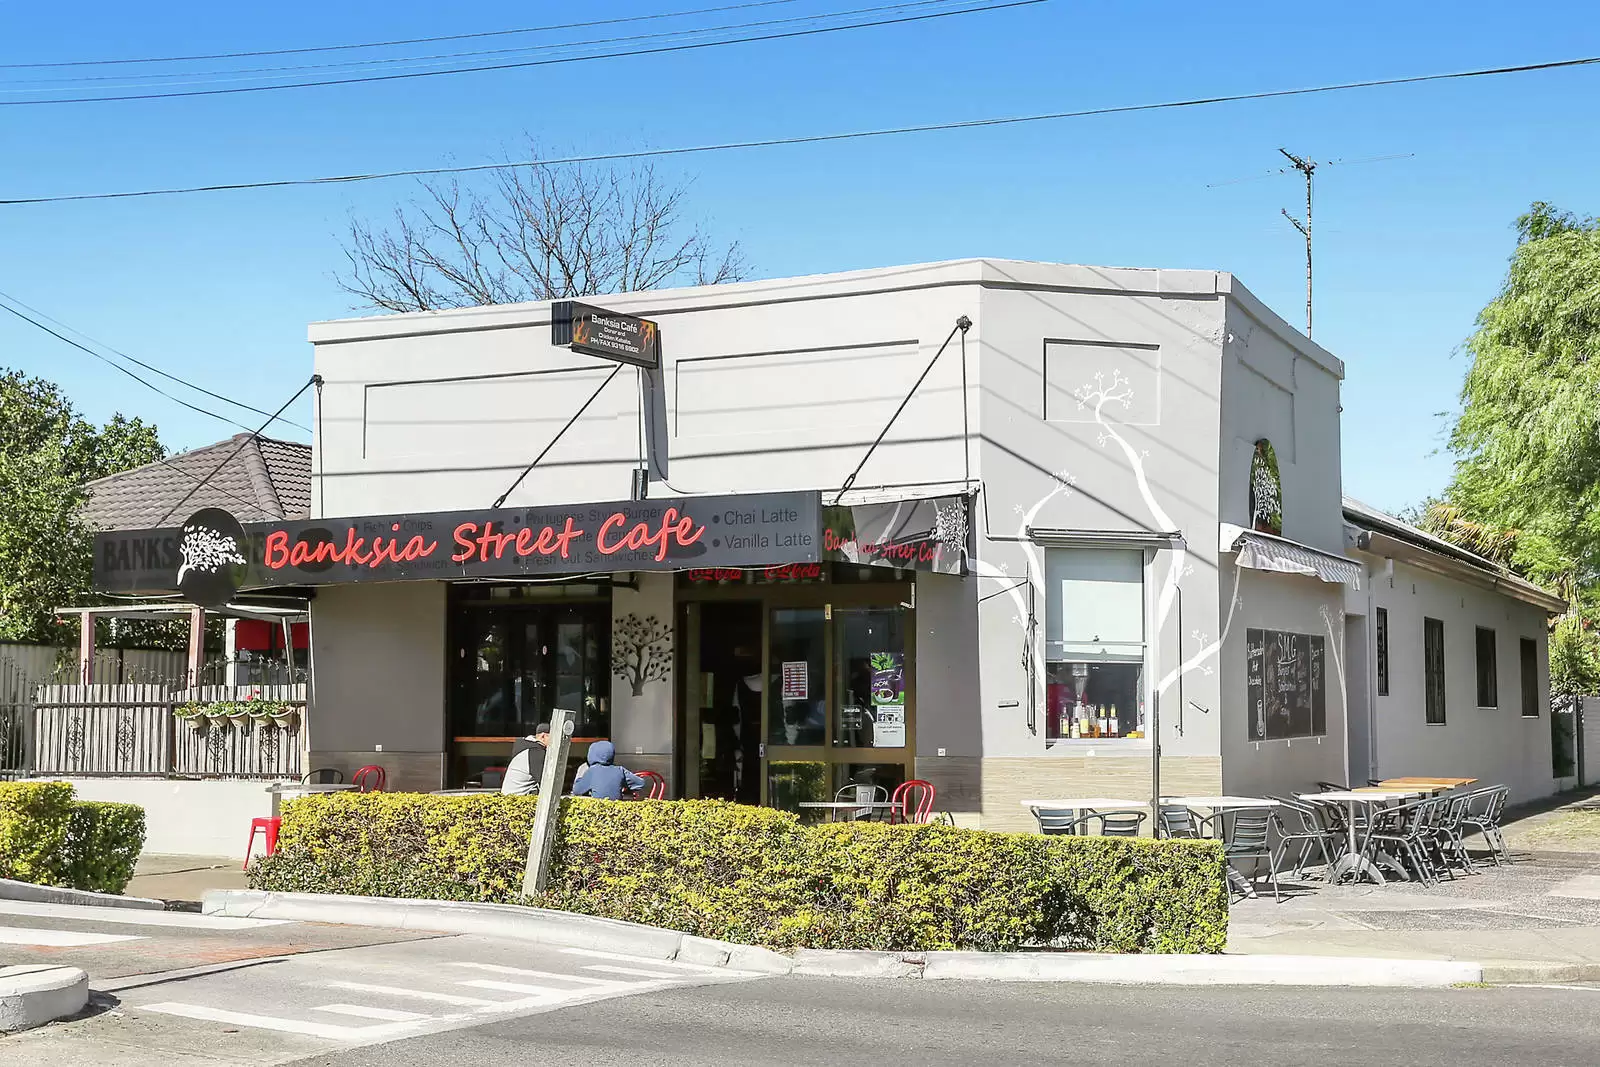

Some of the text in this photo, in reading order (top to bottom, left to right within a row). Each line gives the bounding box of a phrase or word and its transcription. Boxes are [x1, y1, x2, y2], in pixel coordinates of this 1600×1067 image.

[591, 314, 638, 334] Banksia Café
[724, 509, 798, 526] Chai Latte
[264, 523, 438, 570] Banksia
[451, 517, 584, 563] Street
[596, 507, 705, 562] Cafe
[725, 532, 812, 549] Vanilla Latte
[824, 528, 879, 555] Bankia
